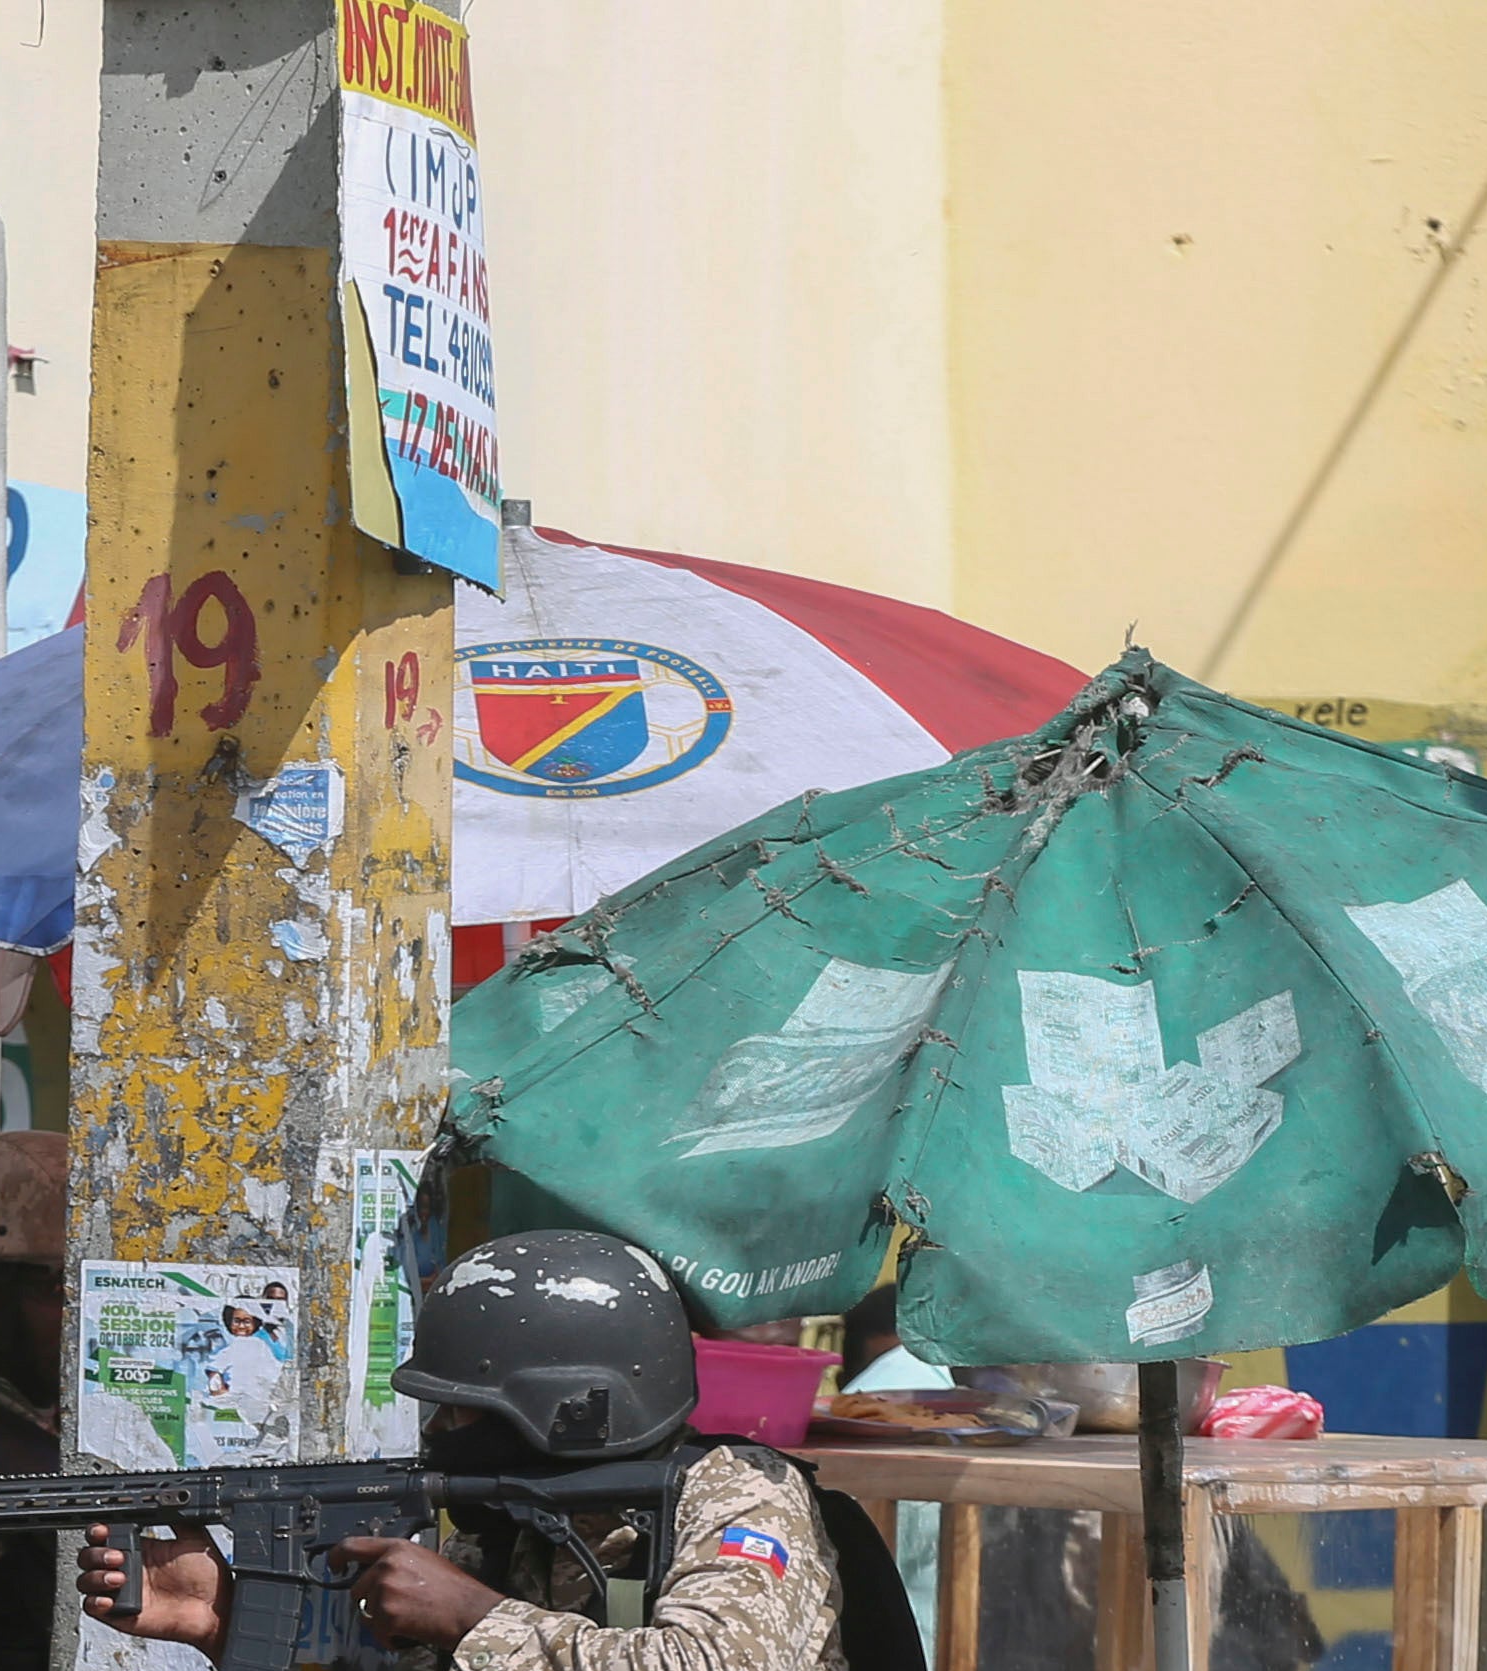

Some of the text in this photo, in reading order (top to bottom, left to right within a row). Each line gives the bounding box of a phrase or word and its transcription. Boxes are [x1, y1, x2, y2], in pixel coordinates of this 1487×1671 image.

[116, 569, 262, 738] 19
[614, 643, 636, 653] DE
[645, 649, 719, 695] FOOTBALL
[384, 651, 419, 730] 19
[94, 1276, 165, 1290] ESNATECH
[701, 1267, 754, 1299] GOU
[753, 1266, 781, 1297] AK
[99, 1317, 175, 1333] SESSION
